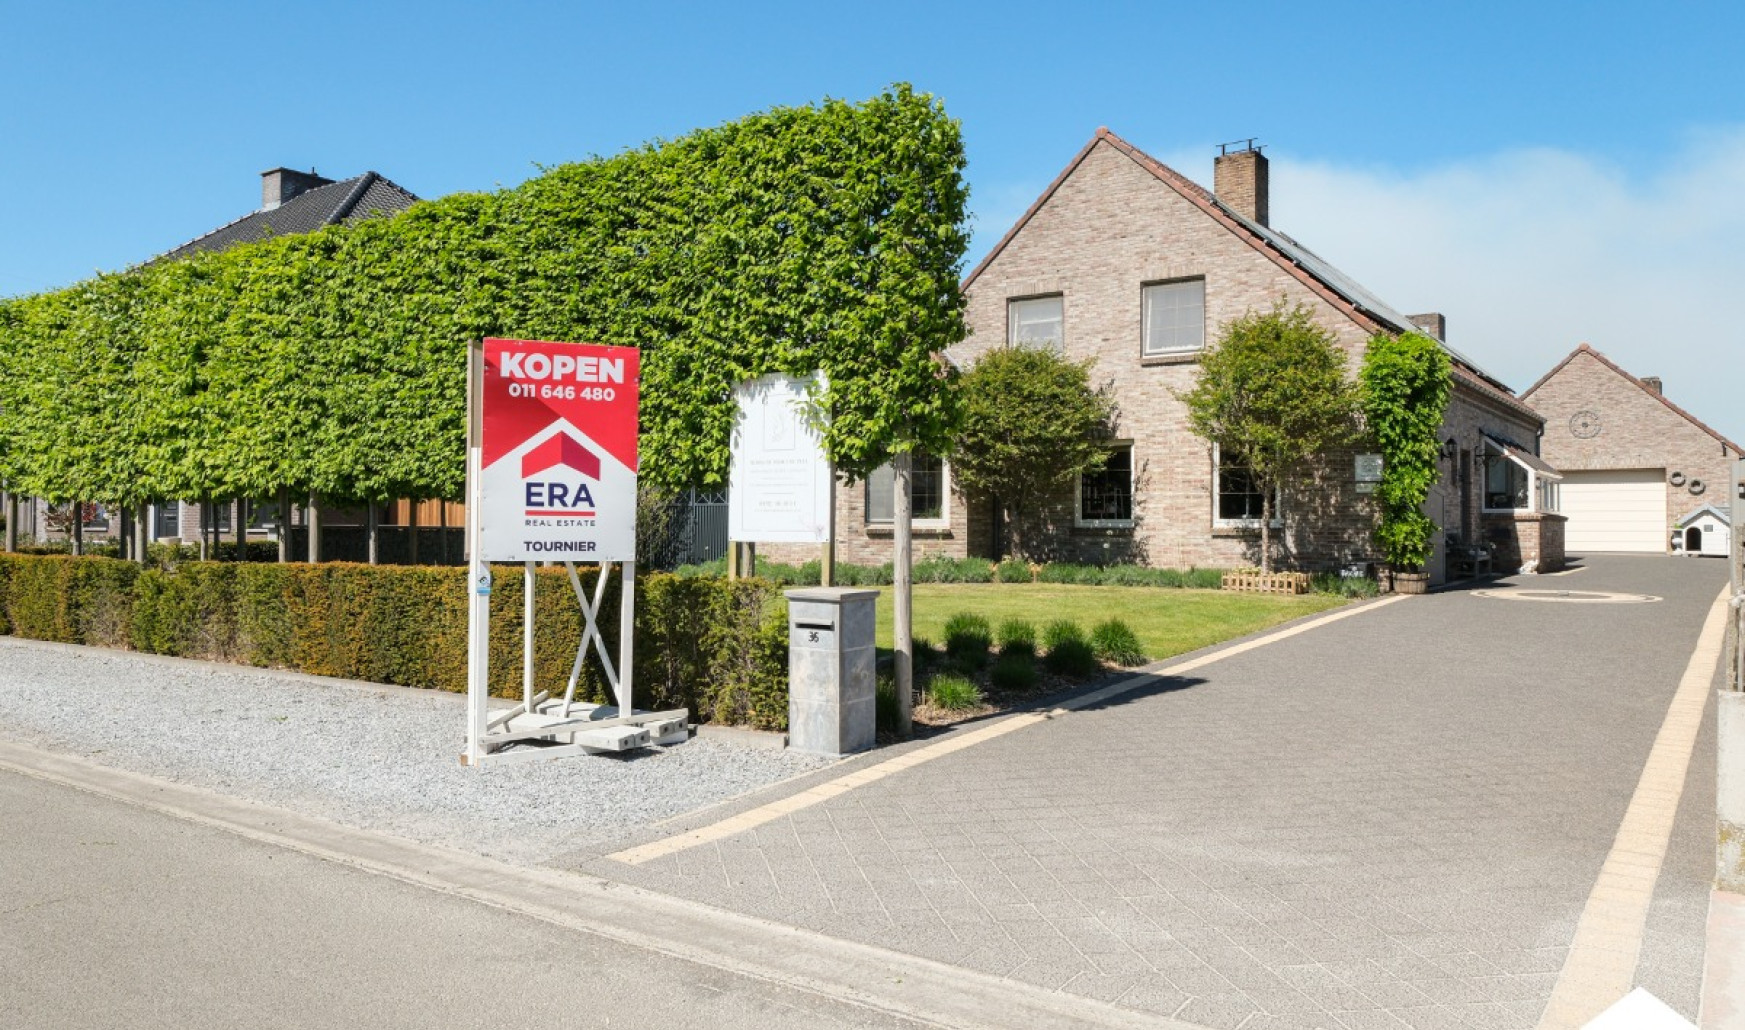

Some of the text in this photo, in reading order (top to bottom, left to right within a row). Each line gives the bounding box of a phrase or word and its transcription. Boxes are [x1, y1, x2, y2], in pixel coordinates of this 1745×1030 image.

[500, 352, 624, 384] KOPEN
[508, 383, 616, 402] 011 646 480
[525, 482, 596, 508] ERA
[524, 519, 596, 528] REAL ESTATE
[523, 541, 597, 552] TOURNIER
